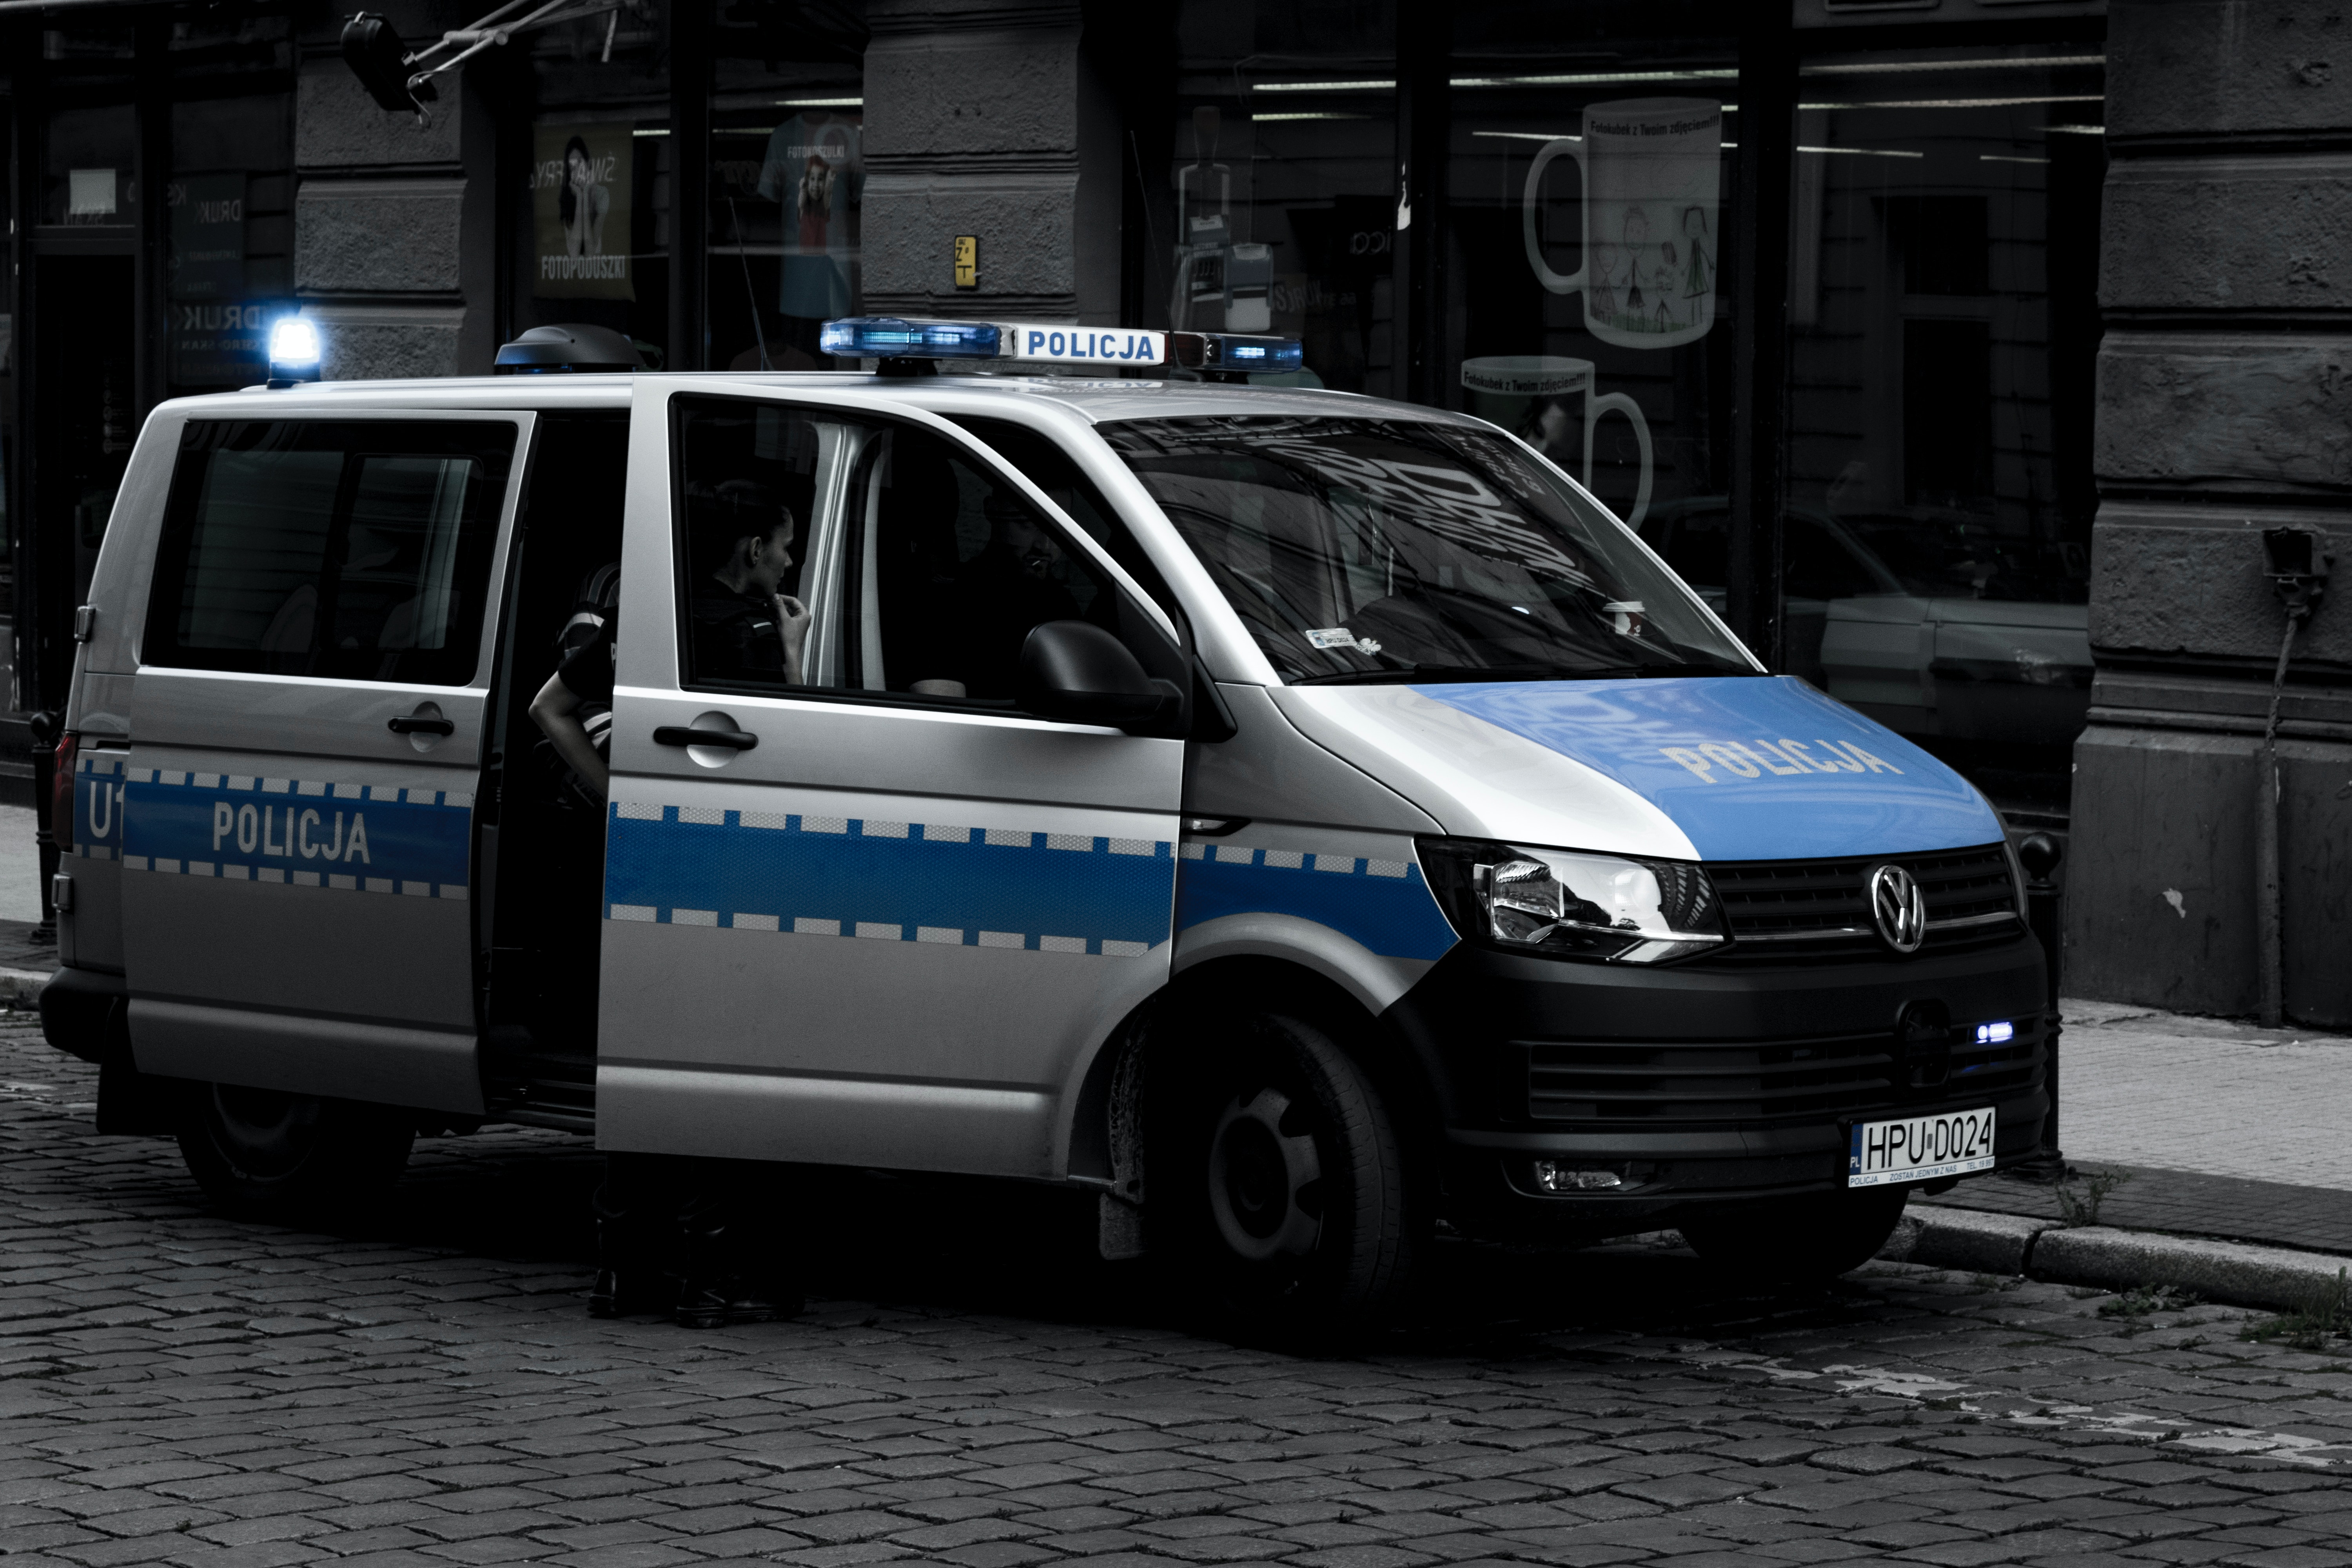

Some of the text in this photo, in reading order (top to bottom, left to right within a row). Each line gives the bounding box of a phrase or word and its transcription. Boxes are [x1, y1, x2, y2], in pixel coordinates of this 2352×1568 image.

[1591, 114, 1719, 136] Fotokubek z Twoim zdjęciem!!!
[541, 255, 626, 280] FOTOPODUSZKI
[1028, 330, 1154, 360] POLICJA
[1464, 371, 1585, 393] Fotokubek z Twoim zdjęciem!!!
[1658, 739, 1906, 784] POLICJA
[213, 801, 370, 864] POLICJA
[1866, 1111, 1992, 1171] HPU D024
[1850, 1156, 1860, 1168] PL
[1850, 1158, 1994, 1186] POLICJA ZOSTAŃ JEDNYM Z NAS TEL. 19 997
